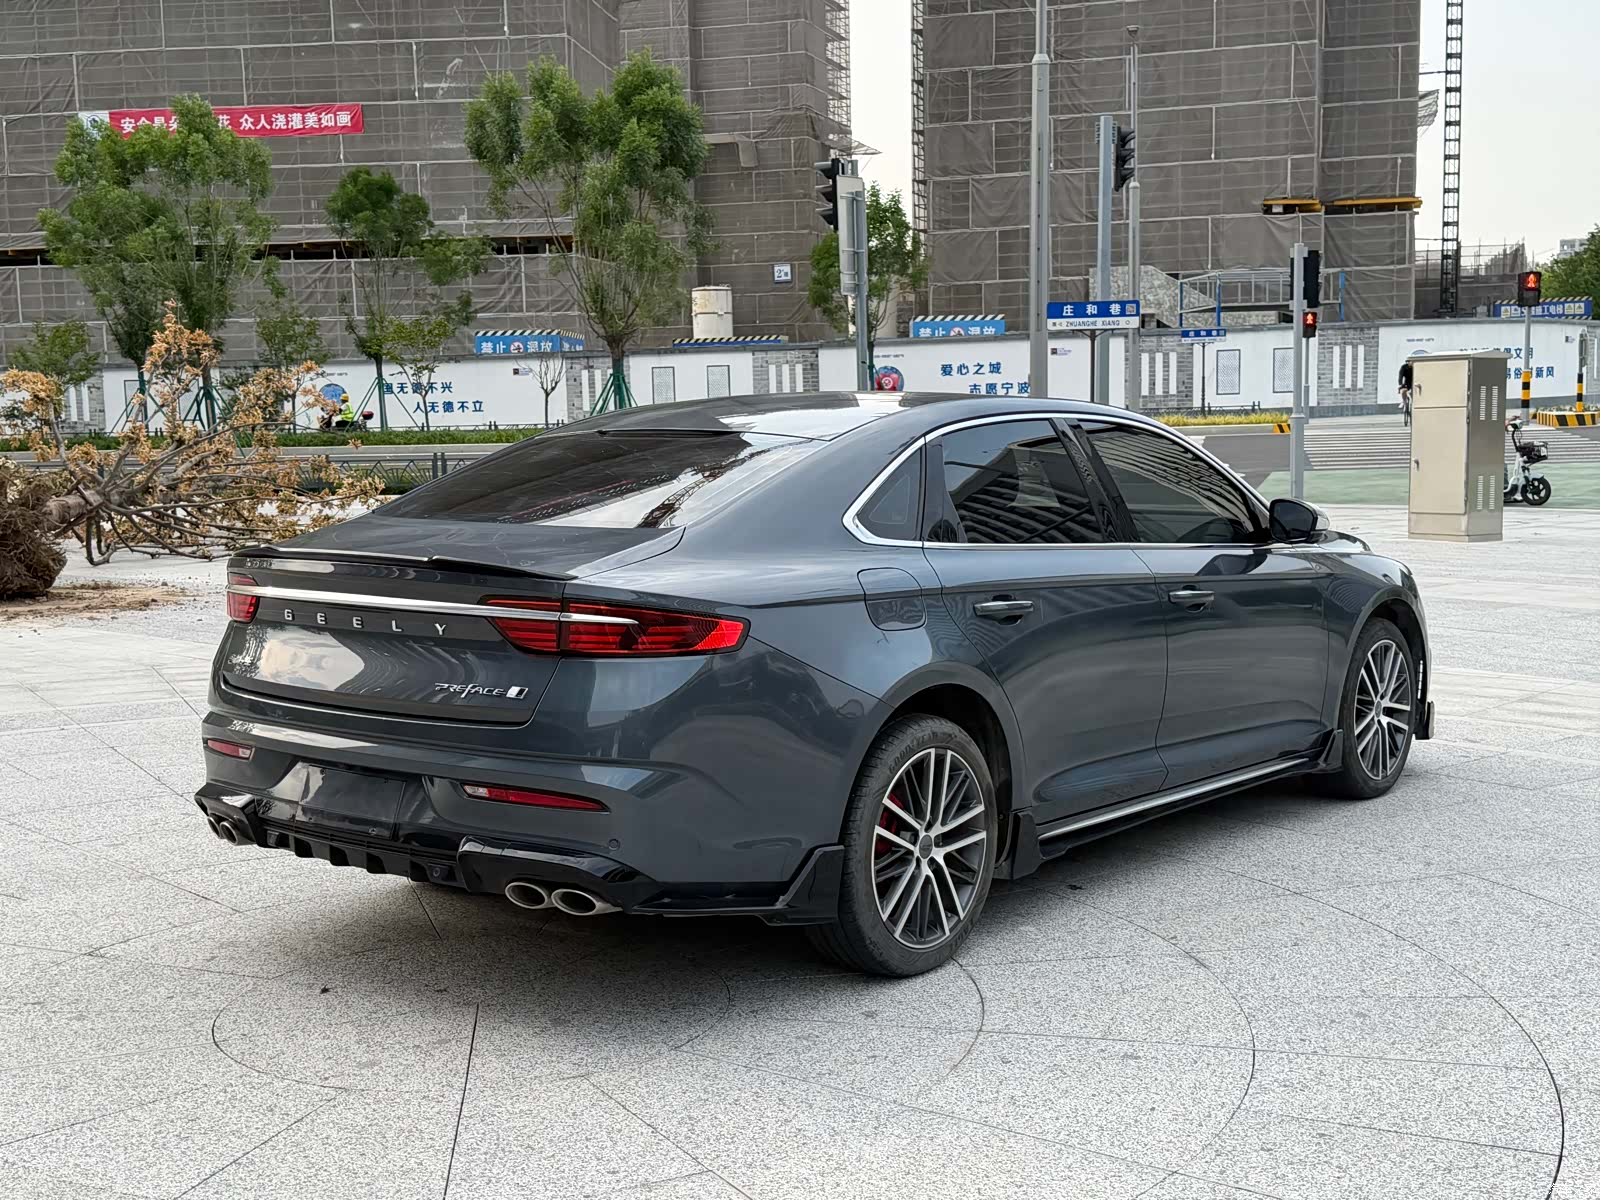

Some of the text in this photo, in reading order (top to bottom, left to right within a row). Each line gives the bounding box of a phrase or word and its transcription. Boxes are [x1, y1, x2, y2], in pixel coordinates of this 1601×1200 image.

[240, 111, 351, 131] 众人浇灌美如画
[1062, 303, 1122, 316] 庄和巷
[1065, 320, 1098, 328] ZHUANGHE
[1101, 319, 1120, 327] XIANG
[480, 341, 506, 353] 禁止
[940, 361, 1002, 377] 爱心之城
[968, 382, 1031, 395] 志愿宁波
[412, 400, 484, 414] 人无德不立
[284, 608, 447, 636] GEELY
